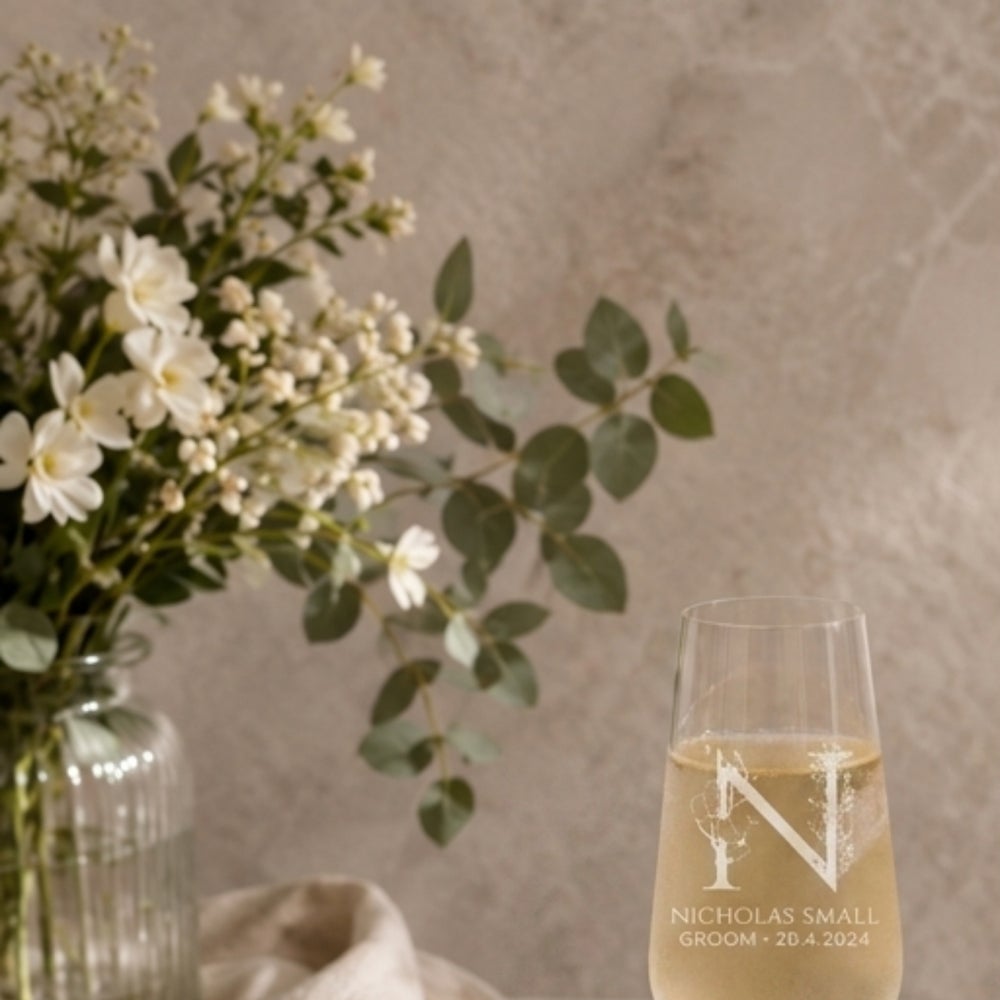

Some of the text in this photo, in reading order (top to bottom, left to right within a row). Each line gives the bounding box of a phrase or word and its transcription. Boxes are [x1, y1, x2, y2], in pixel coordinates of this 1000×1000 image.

[702, 748, 854, 893] N
[670, 906, 881, 926] NICHOLAS SMALL
[679, 930, 757, 947] GROOM
